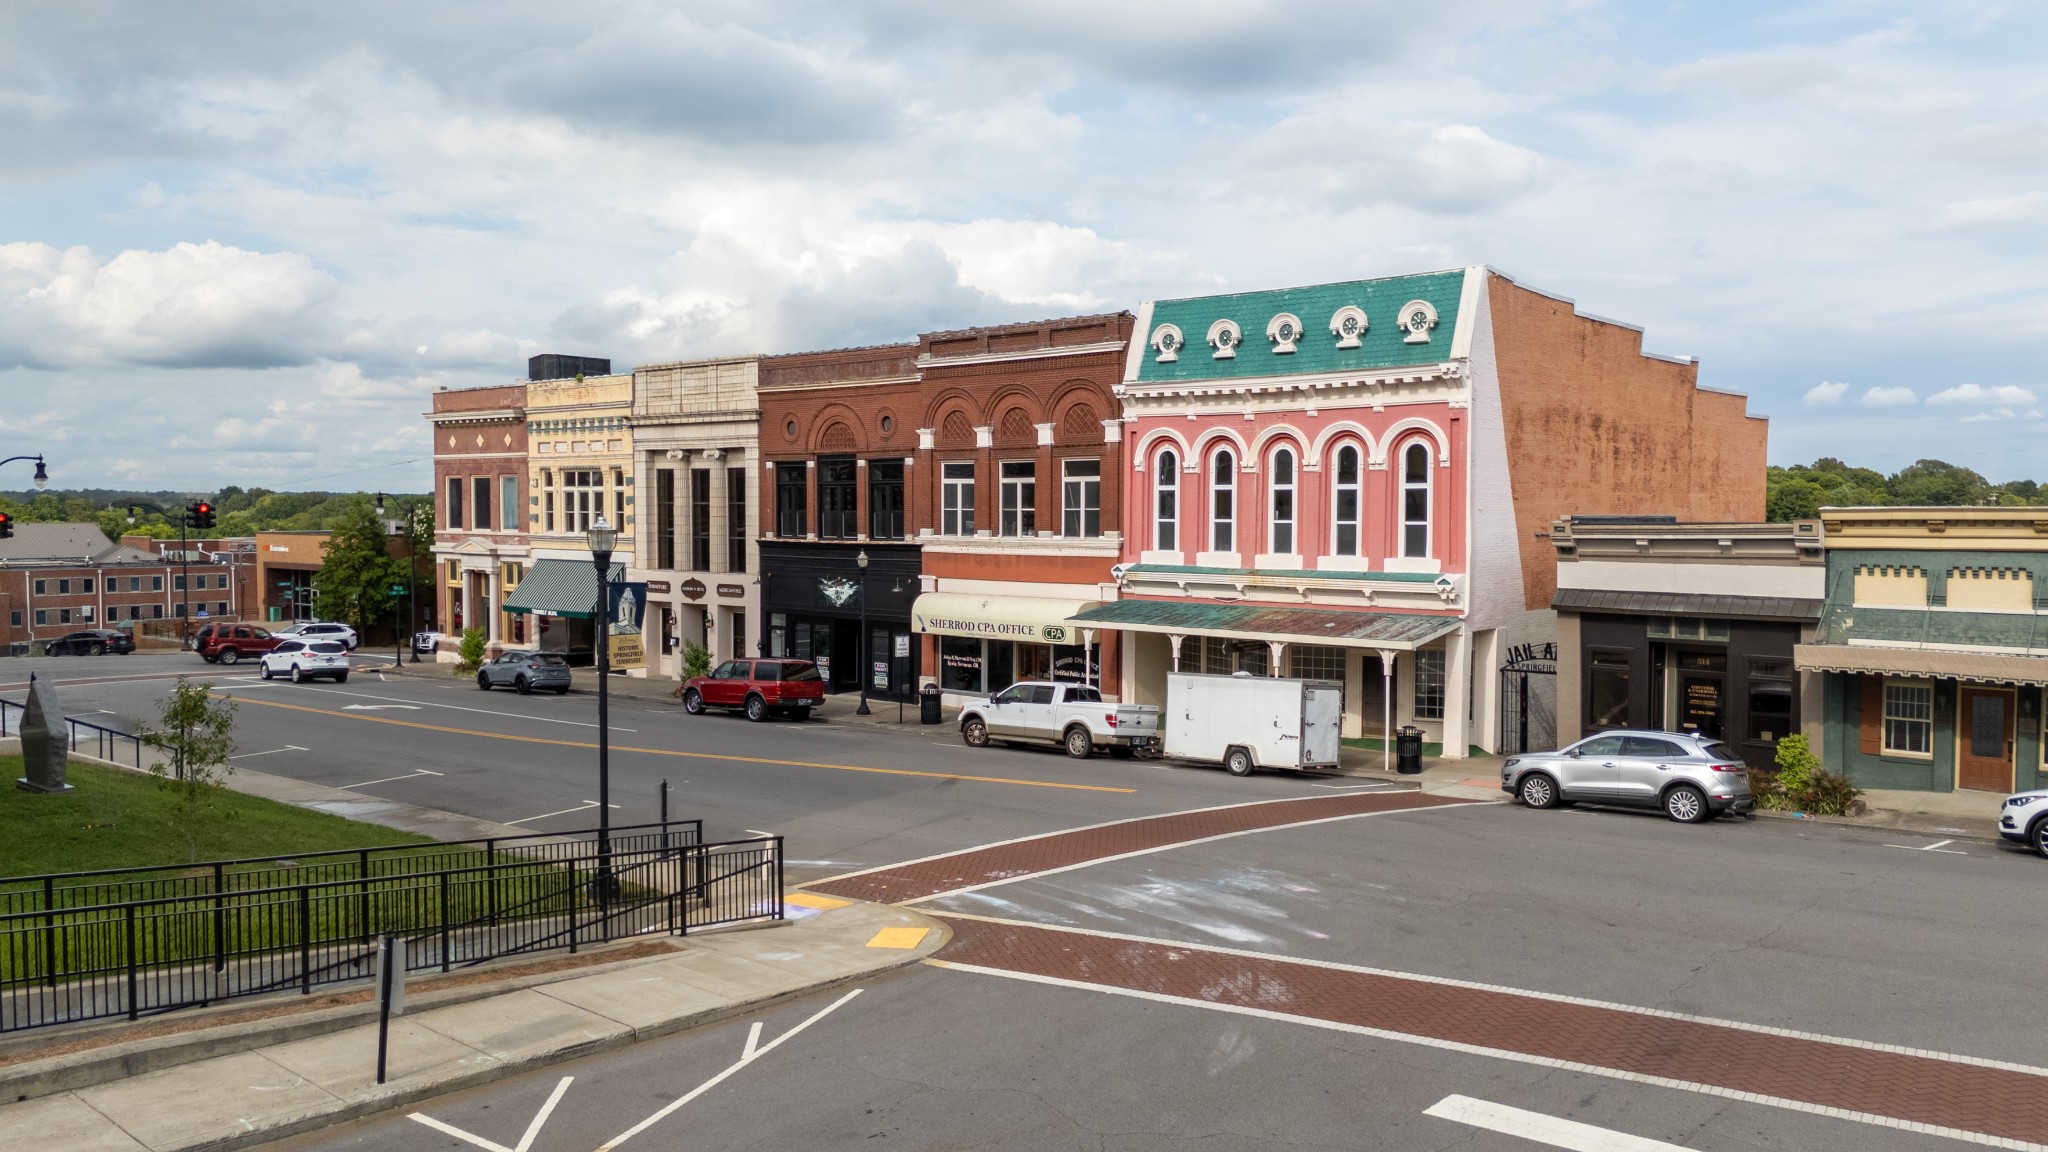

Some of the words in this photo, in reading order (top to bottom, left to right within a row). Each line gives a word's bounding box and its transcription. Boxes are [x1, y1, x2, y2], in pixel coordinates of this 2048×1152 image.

[930, 618, 975, 632] SHERROD
[978, 622, 996, 632] CPA
[998, 624, 1035, 635] OFFICE
[1044, 628, 1063, 639] CPA
[1506, 643, 1536, 664] JAIL
